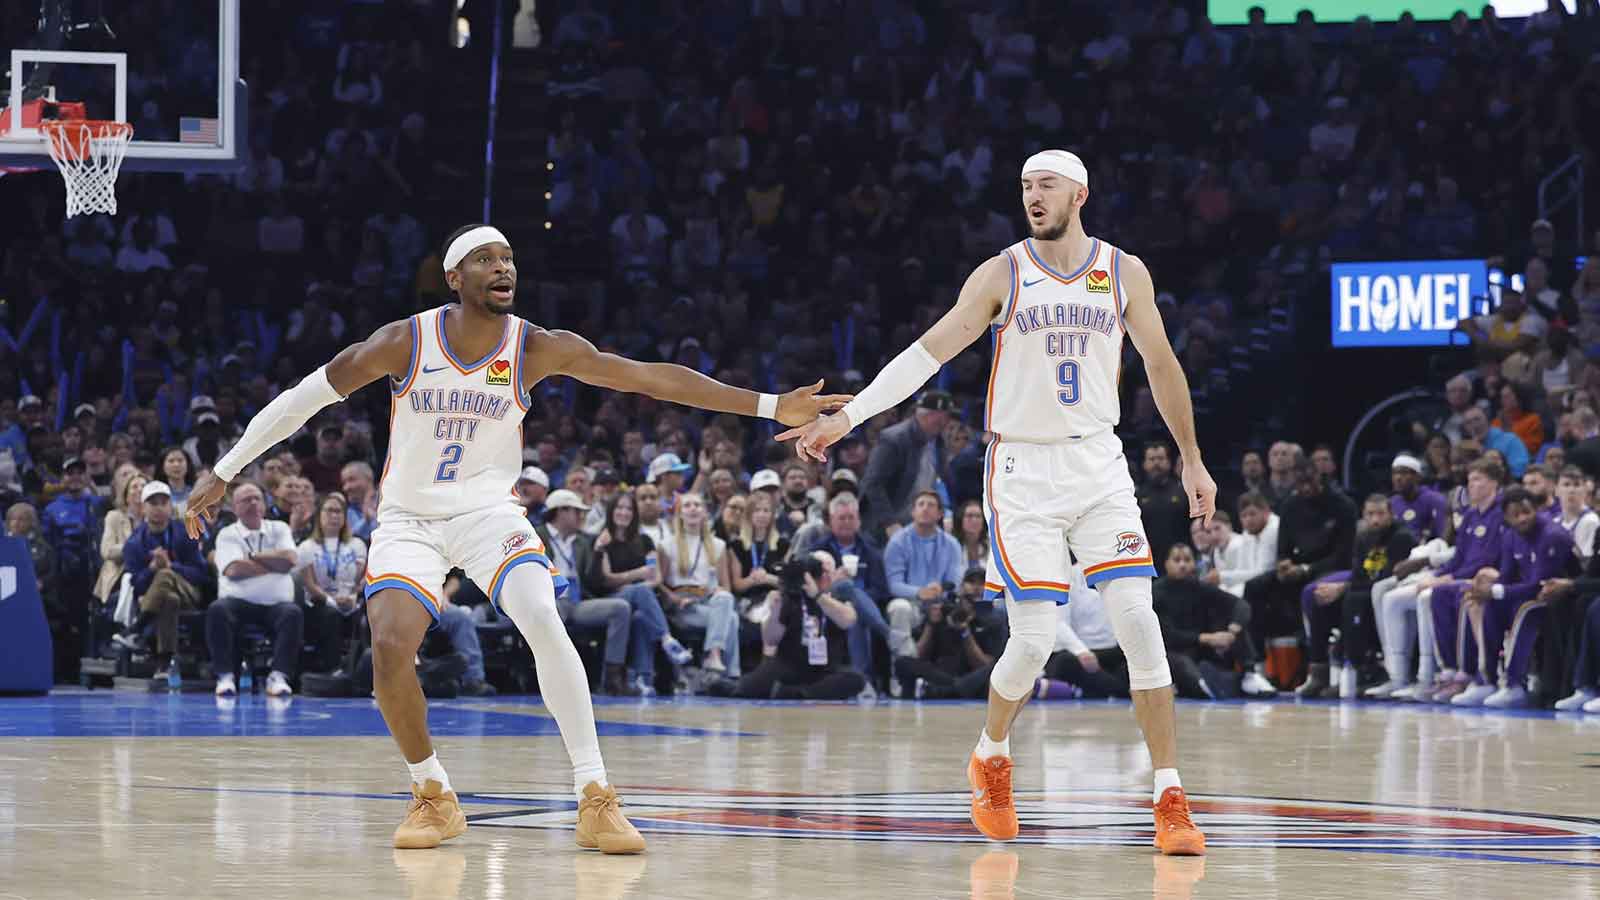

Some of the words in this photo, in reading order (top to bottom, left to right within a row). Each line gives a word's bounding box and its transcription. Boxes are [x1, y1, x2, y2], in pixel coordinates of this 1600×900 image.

[1015, 303, 1117, 336] OKLAHOMA
[1046, 331, 1089, 357] CITY
[1056, 359, 1081, 406] 9
[409, 388, 512, 420] OKLAHOMA
[434, 417, 480, 441] CITY
[433, 442, 465, 483] 2
